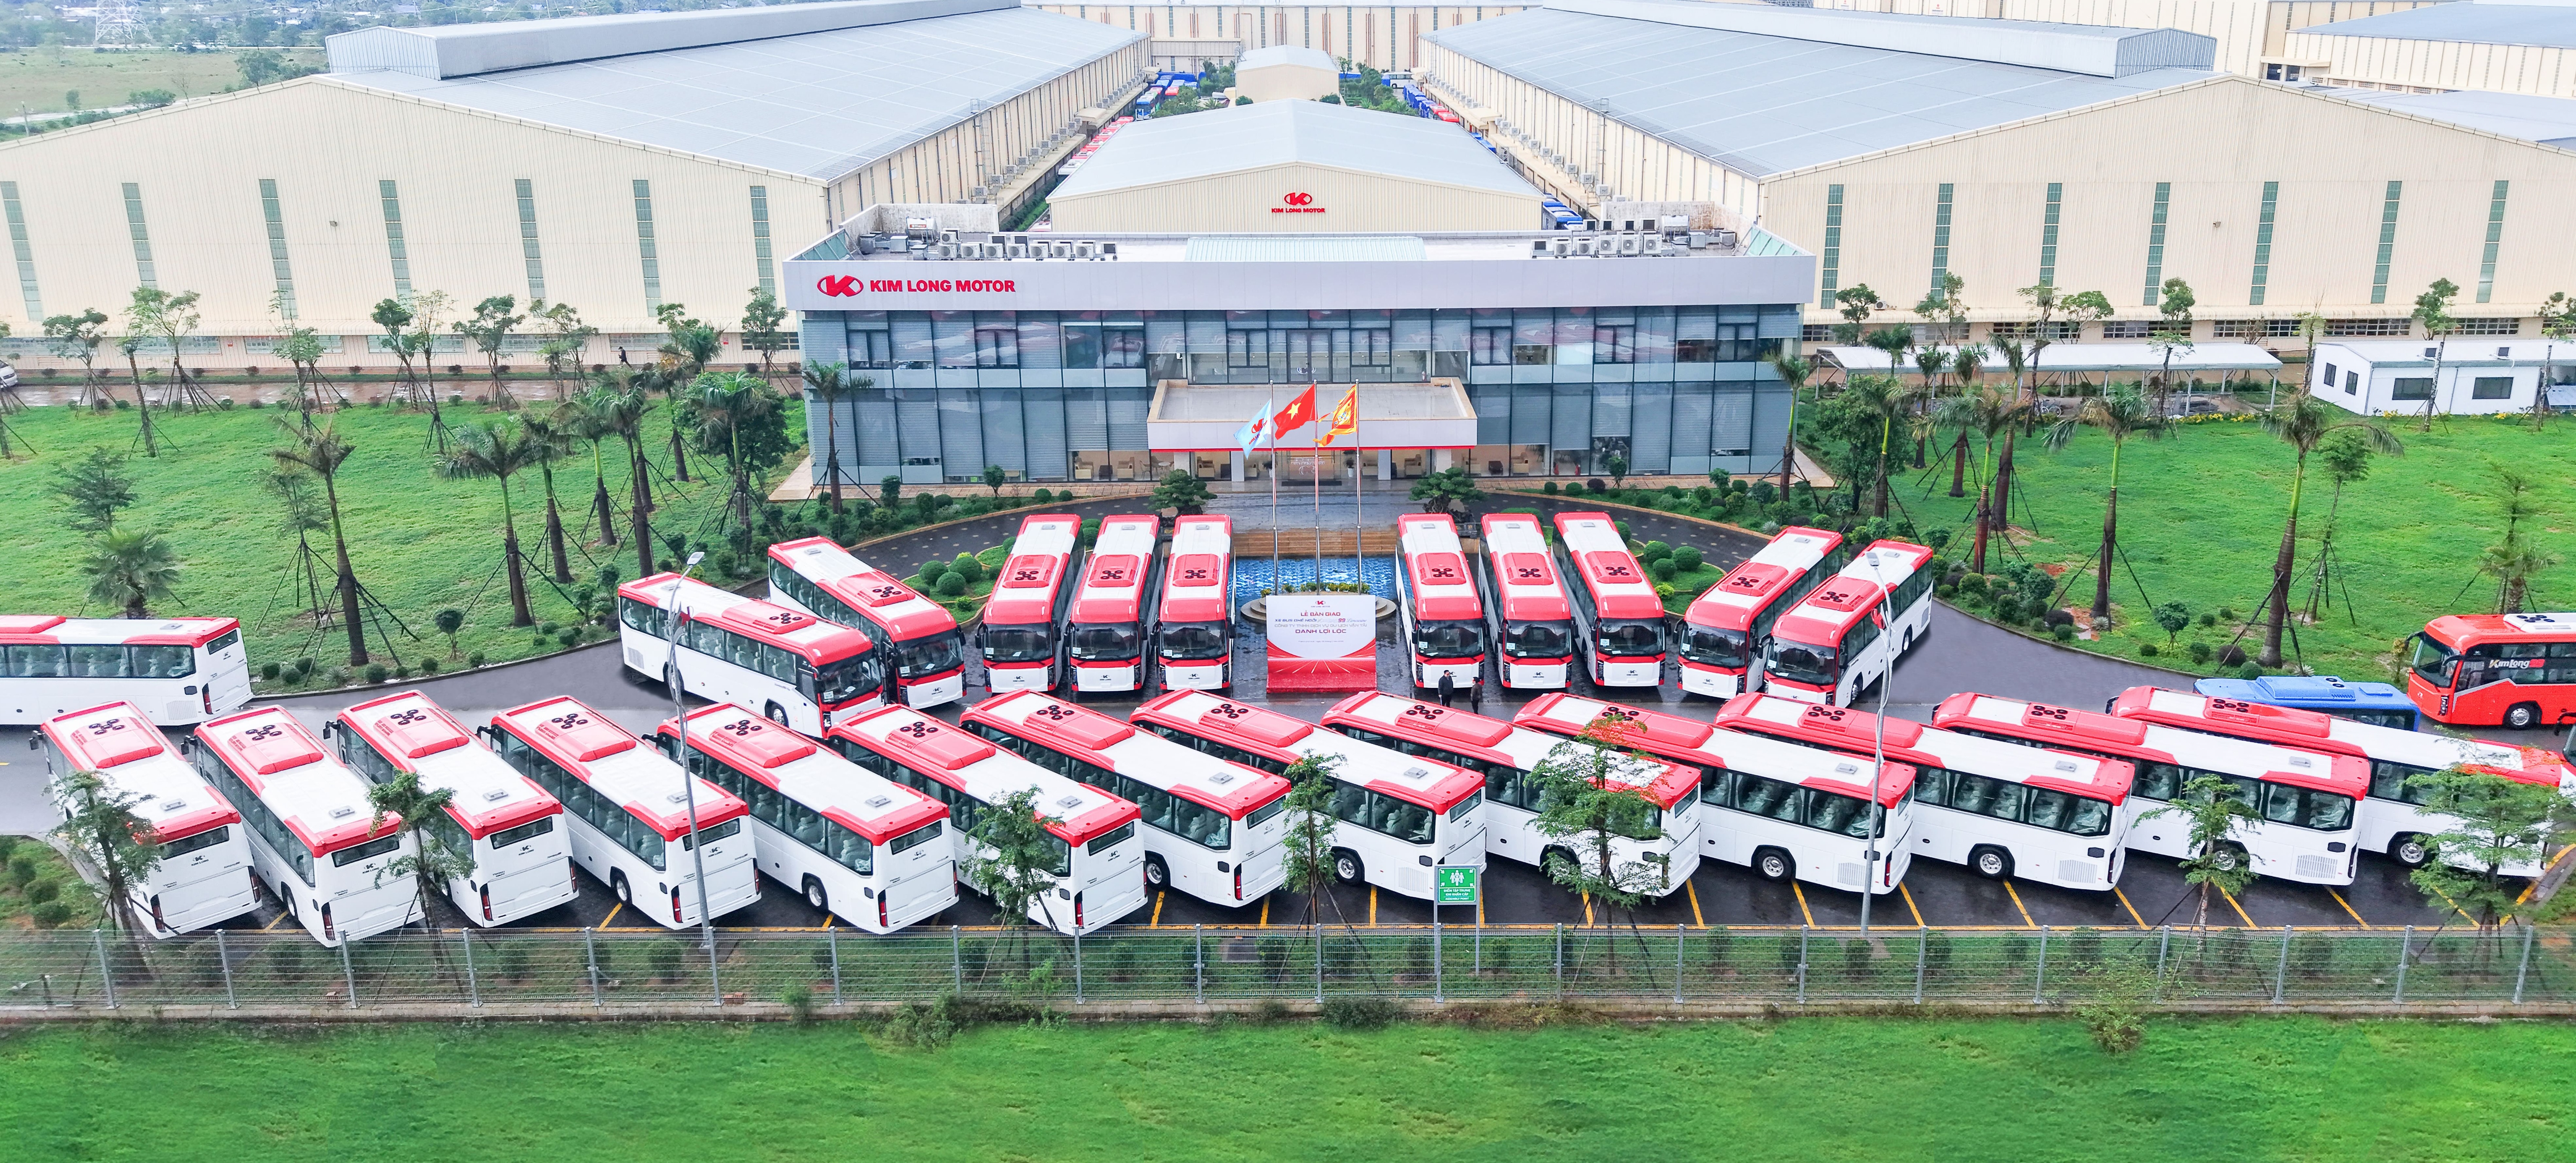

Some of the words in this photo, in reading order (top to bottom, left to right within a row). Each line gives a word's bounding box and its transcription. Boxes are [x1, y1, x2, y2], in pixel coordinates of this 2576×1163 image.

[870, 280, 903, 292] KIM
[908, 280, 951, 292] LONG
[956, 280, 1016, 292] MOTOR
